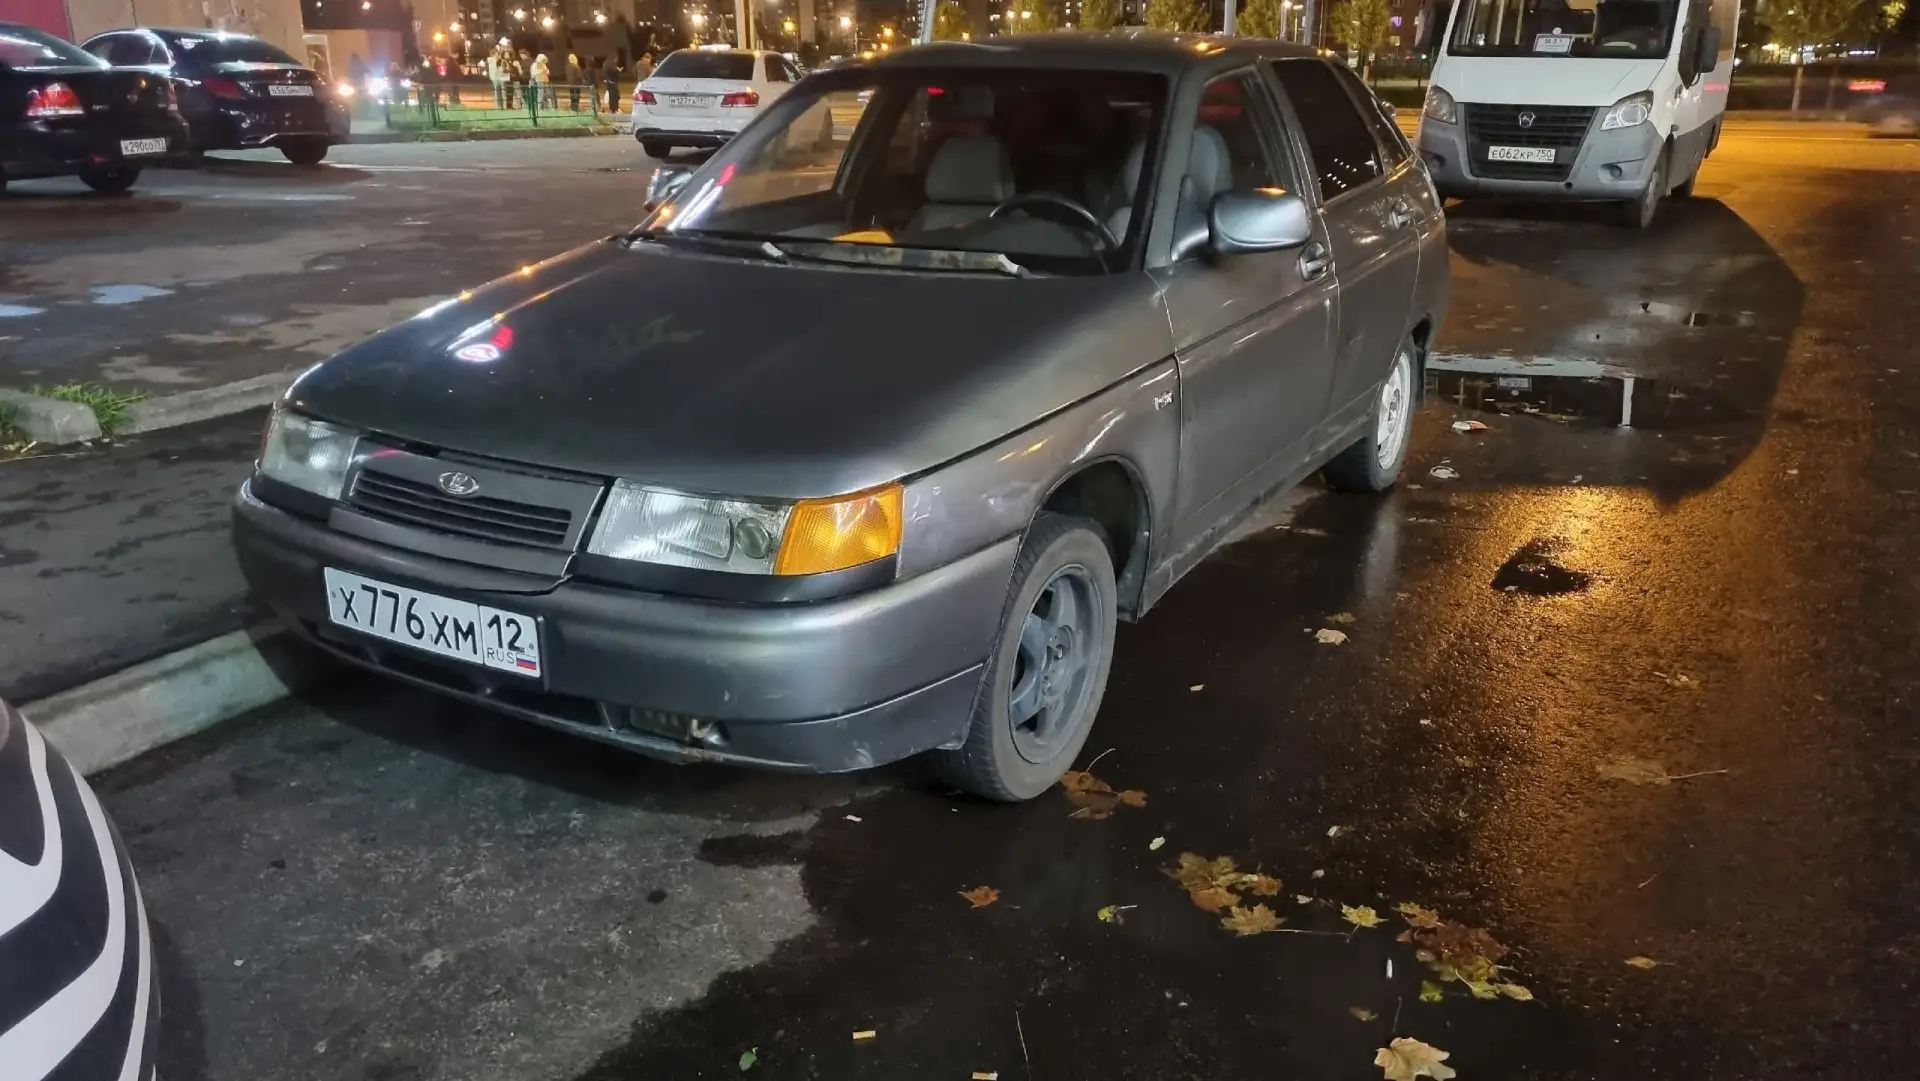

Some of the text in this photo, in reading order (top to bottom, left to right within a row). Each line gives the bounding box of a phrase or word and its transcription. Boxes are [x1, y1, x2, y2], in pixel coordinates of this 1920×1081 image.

[1492, 148, 1553, 159] Е062КР 750
[339, 583, 526, 656] Х776ХМ 12
[486, 647, 515, 665] RUS
